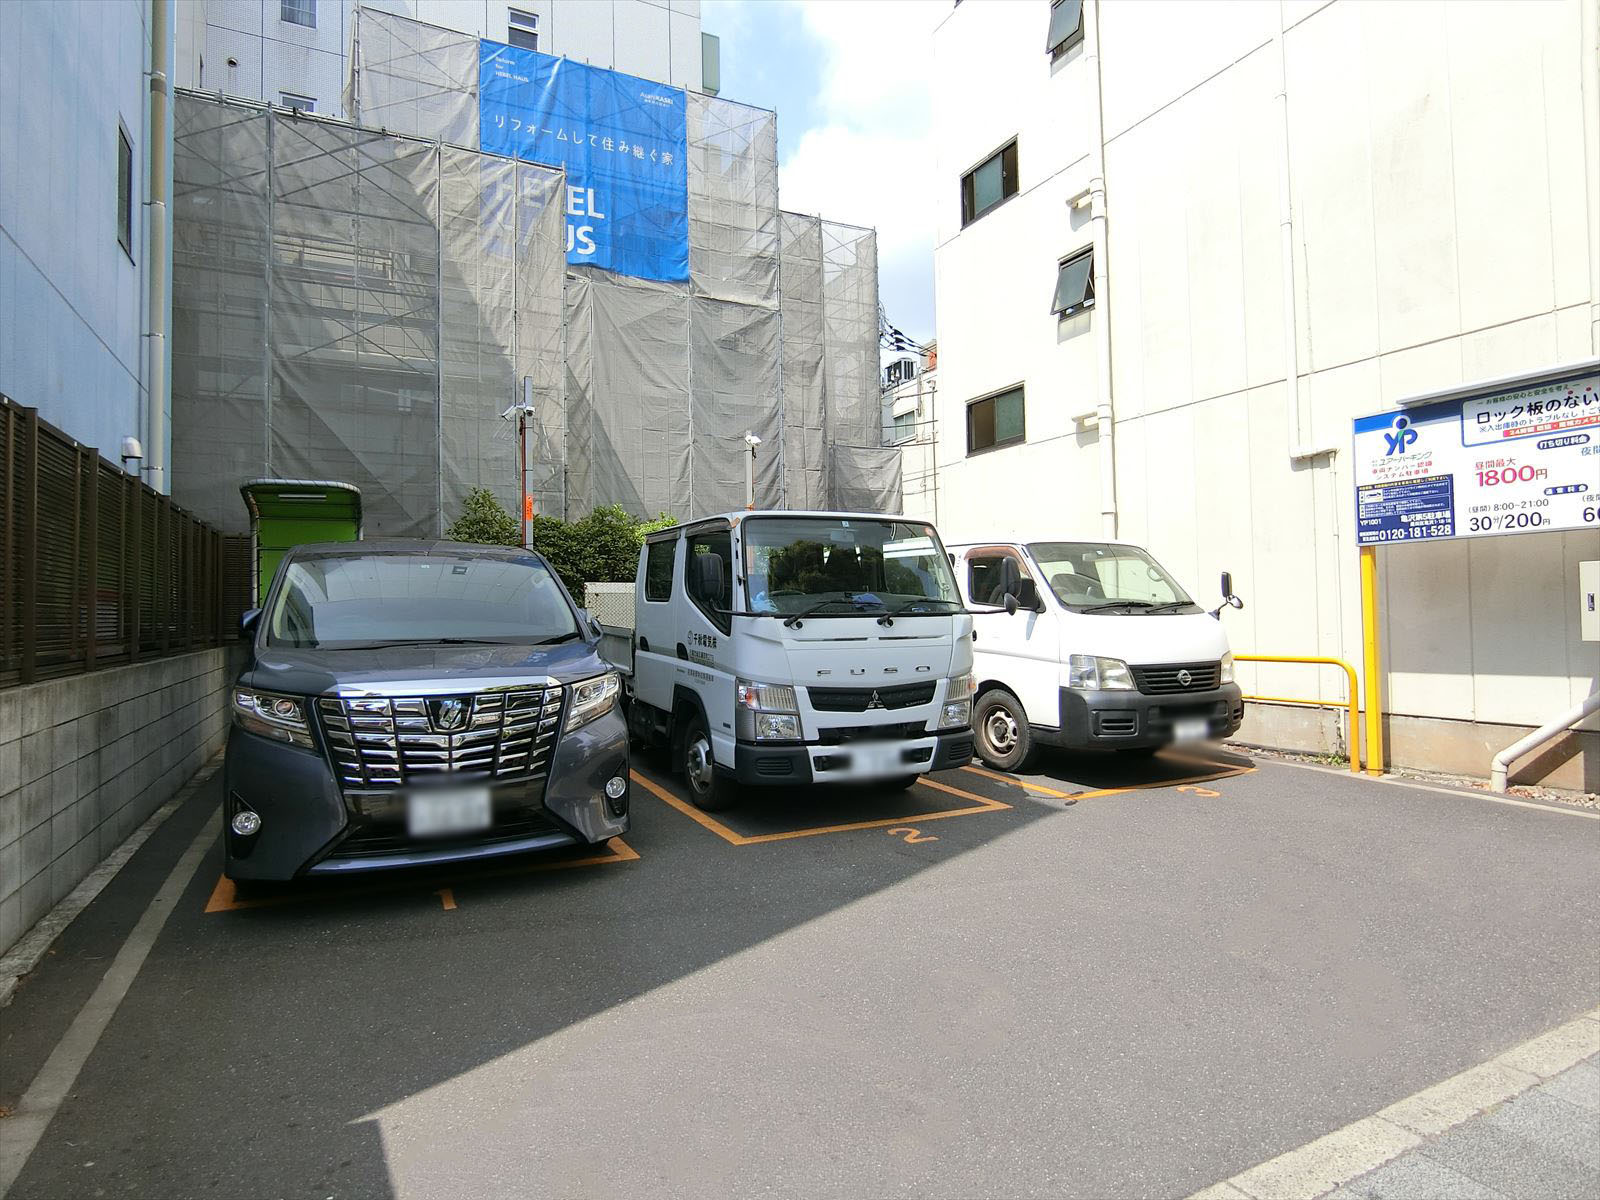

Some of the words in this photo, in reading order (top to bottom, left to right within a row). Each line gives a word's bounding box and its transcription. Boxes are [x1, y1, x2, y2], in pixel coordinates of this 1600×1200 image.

[495, 114, 674, 166] リフォームして住み継ぐ家
[1477, 392, 1600, 424] ロック板のない
[1475, 457, 1516, 471] 昼間最大
[1476, 465, 1548, 487] 1800円
[1379, 524, 1452, 541] 0120-181-528
[816, 665, 931, 677] FUSO
[887, 827, 939, 845] 2
